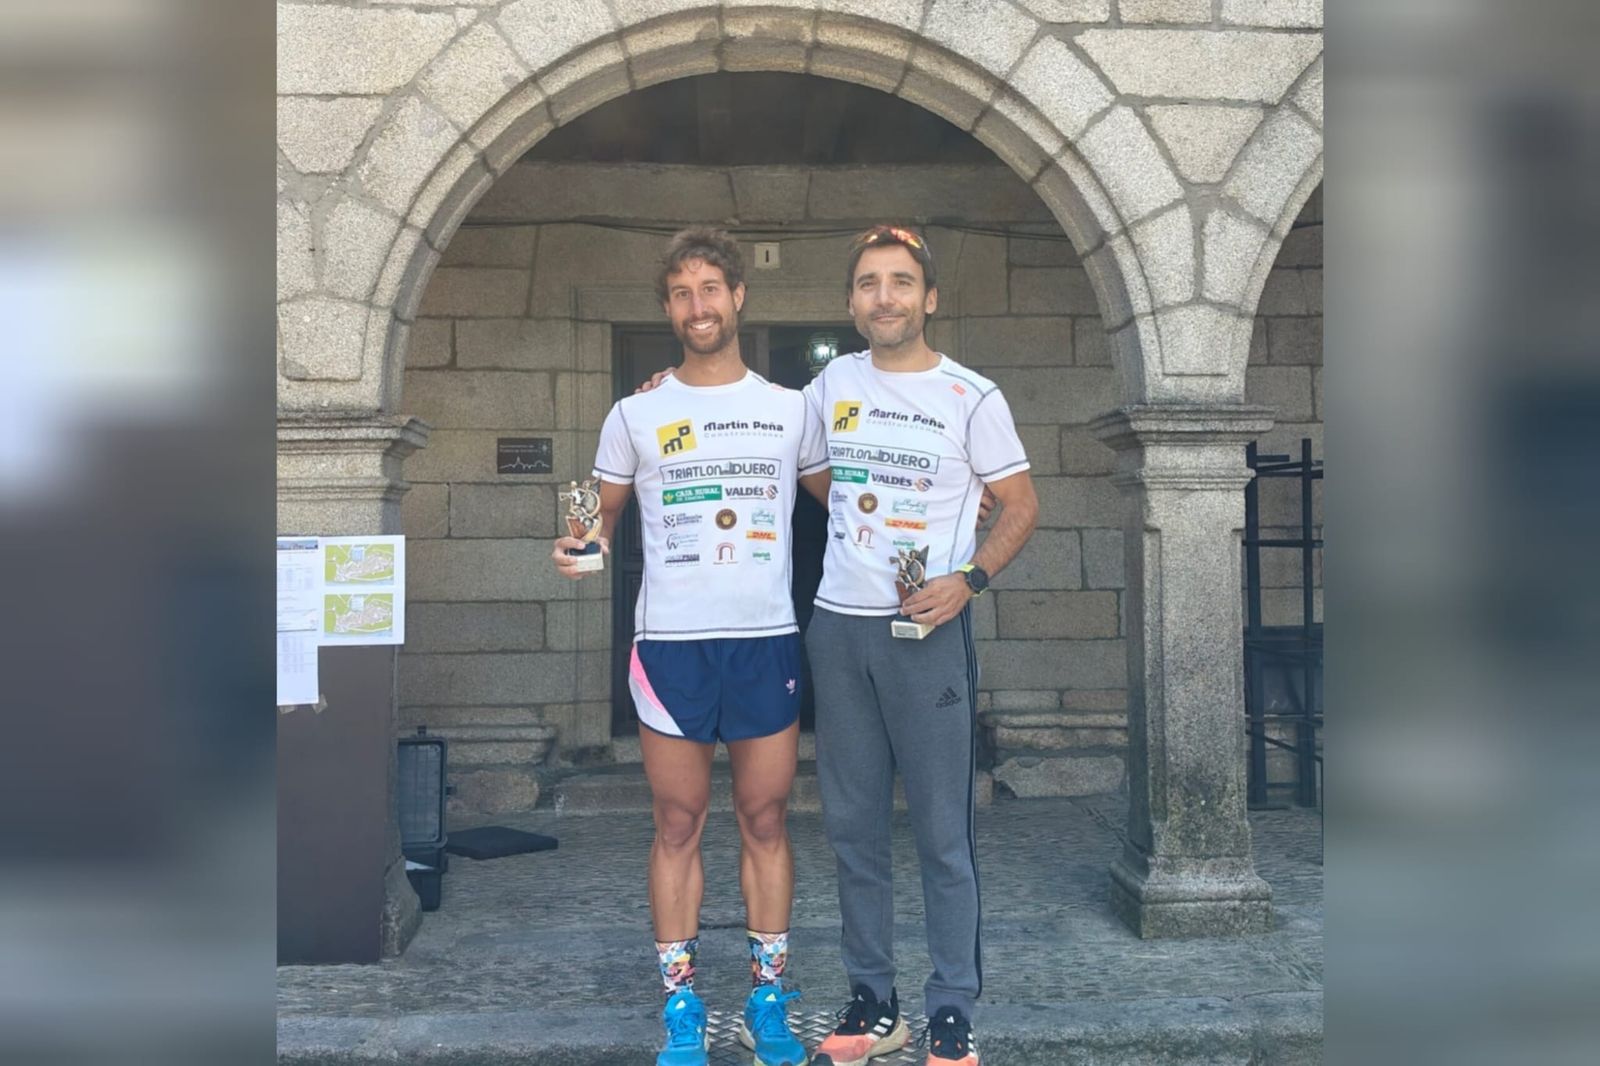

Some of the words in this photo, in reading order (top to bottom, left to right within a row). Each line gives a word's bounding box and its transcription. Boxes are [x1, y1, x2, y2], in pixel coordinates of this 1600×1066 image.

[753, 421, 784, 432] Peña
[912, 414, 946, 430] Peña
[881, 451, 931, 470] DUERO
[668, 464, 721, 480] TRIATLON
[733, 463, 776, 476] DUERO
[871, 472, 913, 487] VALDÉS
[725, 486, 764, 496] VALDÉS
